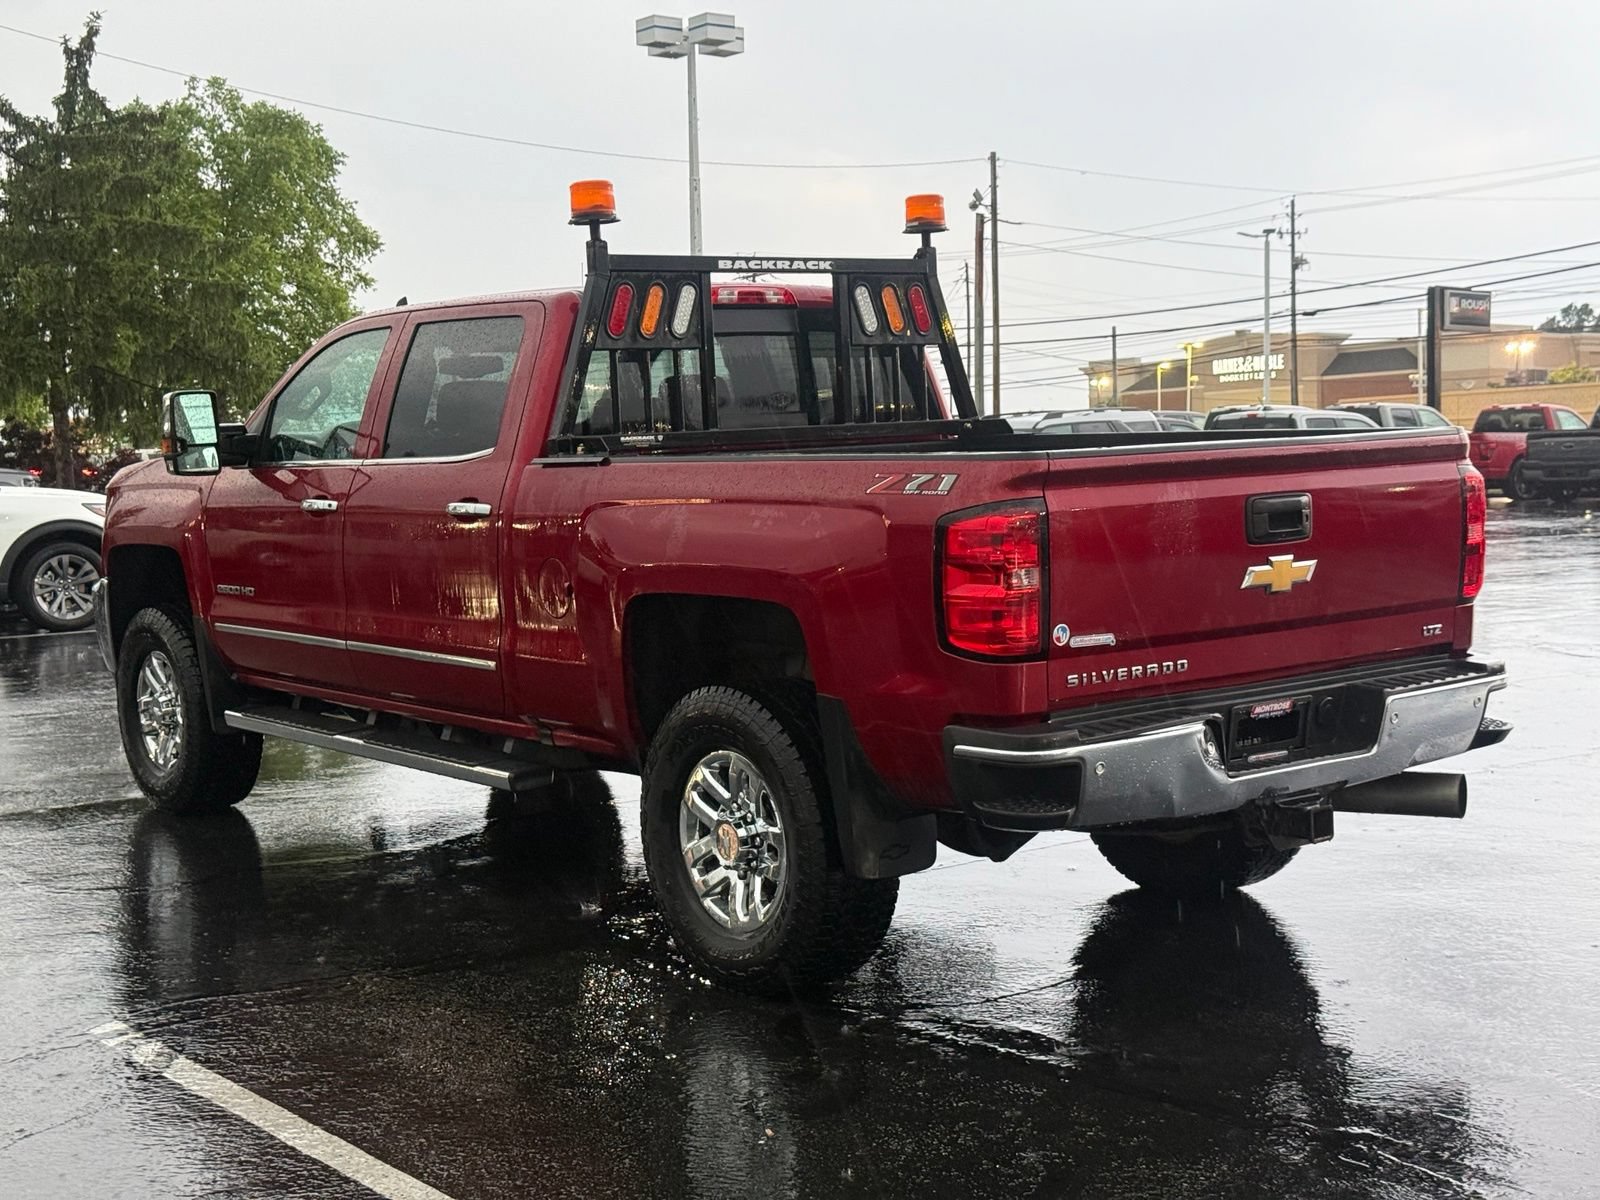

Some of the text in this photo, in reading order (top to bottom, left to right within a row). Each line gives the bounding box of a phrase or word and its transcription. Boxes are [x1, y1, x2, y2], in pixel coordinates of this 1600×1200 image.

[718, 260, 832, 270] BACKRACK
[865, 473, 959, 494] Z71
[241, 586, 255, 597] HD
[1423, 623, 1443, 637] LTZ
[1066, 659, 1188, 688] SILVERADO
[1253, 701, 1292, 714] MONTROSE
